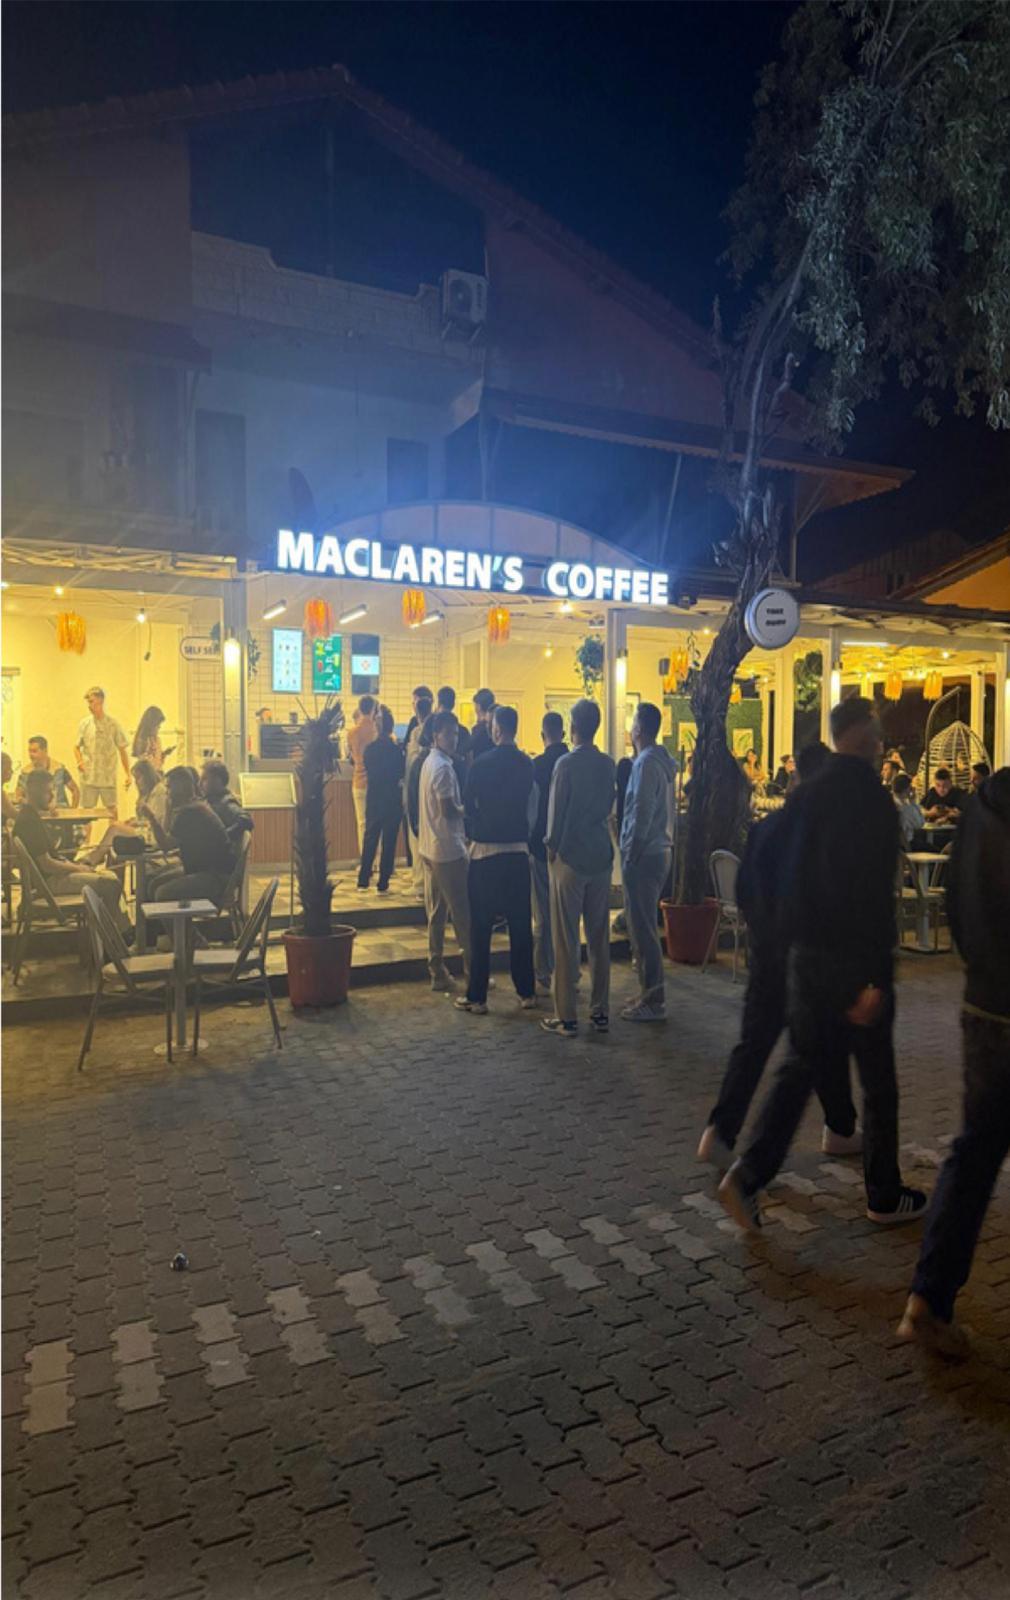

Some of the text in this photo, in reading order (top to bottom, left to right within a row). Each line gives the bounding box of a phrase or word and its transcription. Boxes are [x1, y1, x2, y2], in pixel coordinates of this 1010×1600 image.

[277, 529, 670, 605] MACLAREN'S COFFEE
[184, 645, 202, 654] SELF
